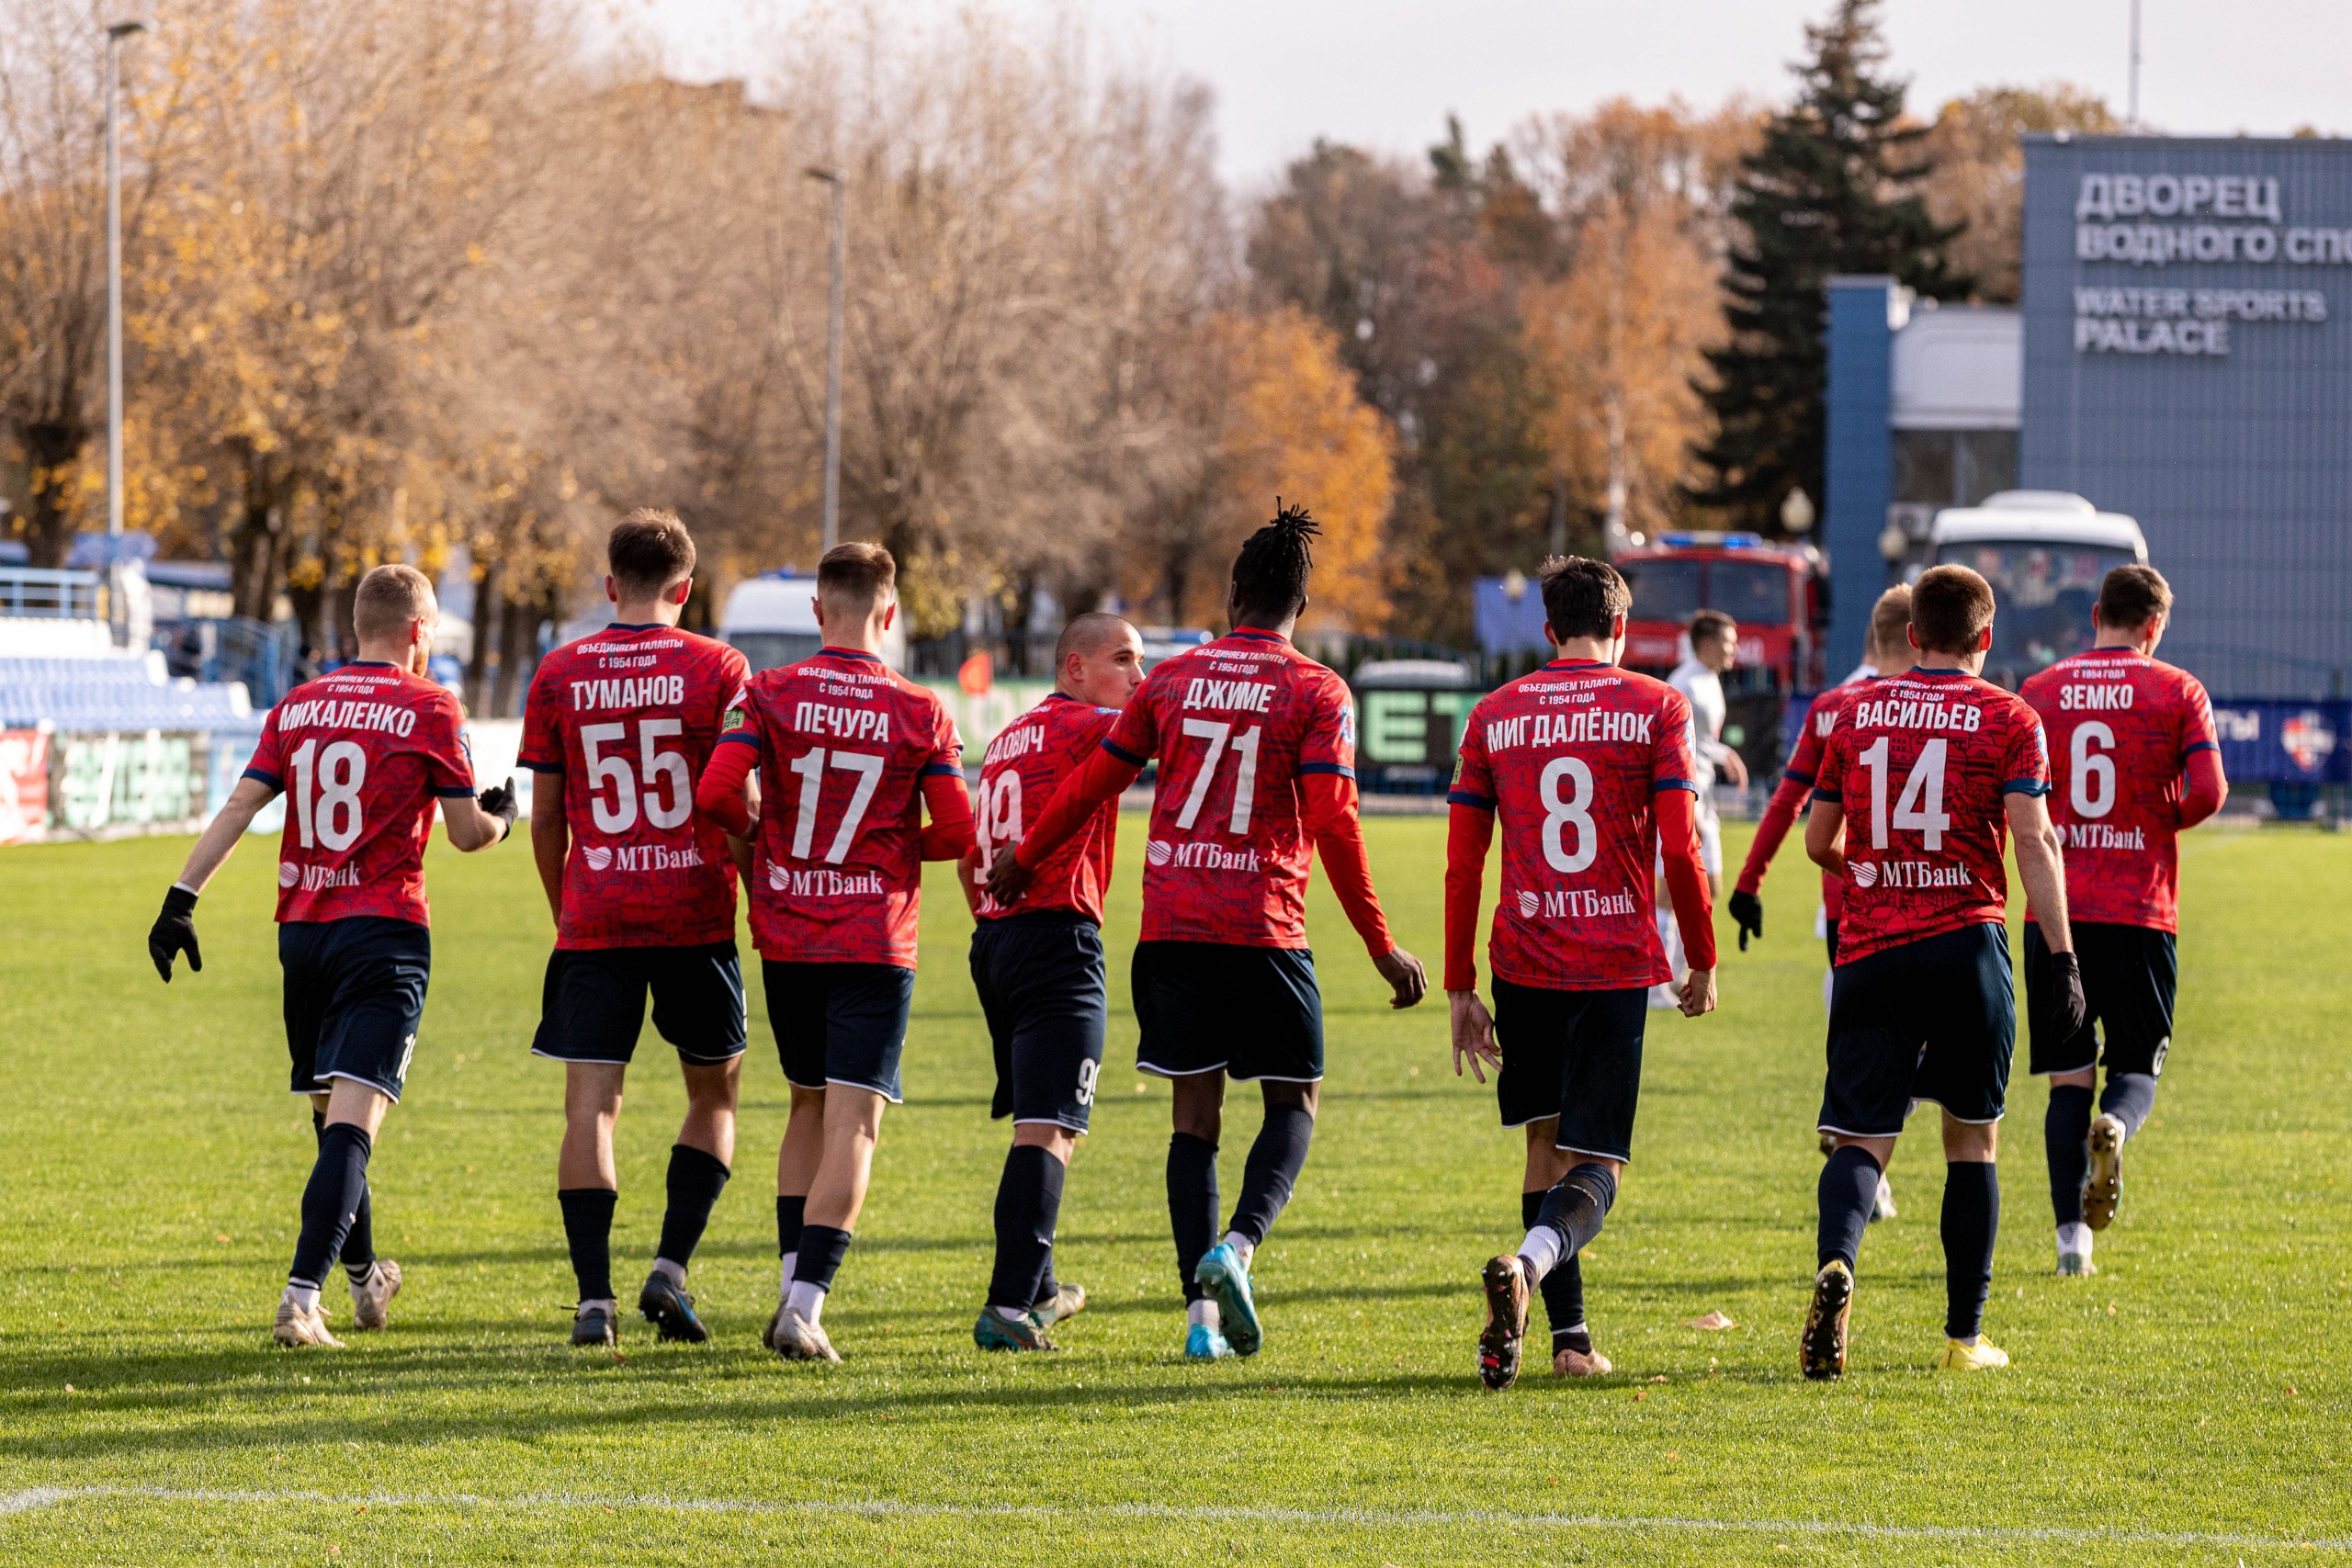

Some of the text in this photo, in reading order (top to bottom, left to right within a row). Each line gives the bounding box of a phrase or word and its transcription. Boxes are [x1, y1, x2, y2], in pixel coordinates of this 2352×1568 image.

[2075, 174, 2281, 224] ДВОРЕЦ
[2075, 224, 2352, 268] ВОДНОГО СП
[2074, 286, 2327, 321] WATER SPORTS
[2074, 318, 2231, 355] PALACE
[608, 656, 631, 669] 1954
[632, 654, 657, 668] ГОДА
[639, 638, 684, 651] ТАЛАНТЫ
[1248, 651, 1288, 666] ТАЛАНТЫ
[857, 673, 898, 688] ТАЛАНТЫ
[1217, 661, 1238, 672] 1954
[1238, 663, 1259, 675] ГОДА
[1518, 677, 1622, 694] ОБЪЕДИНЯЕМ ТАЛАНТЫ
[570, 675, 684, 712] ТУМАНОВ
[828, 683, 849, 696] 1954
[851, 685, 873, 700] ГОДА
[1182, 678, 1276, 714] ДЖИМЕ
[1540, 693, 1596, 705] С 1954 ГОДА
[1899, 690, 1920, 700] 1954
[1921, 692, 1945, 702] ГОДА
[2059, 684, 2133, 711] ЗЕМКО
[278, 699, 416, 739] МИХАЛЕНКО
[794, 702, 889, 743] ПЕЧУРА
[1487, 706, 1655, 754] МИГДАЛЁНОК
[1855, 699, 1982, 732] ВАСИЛЬЕВ
[580, 718, 693, 834] 55
[1175, 717, 1261, 835] 71
[2070, 720, 2116, 818] 6
[290, 739, 367, 852] 18
[790, 746, 885, 864] 17
[1860, 736, 1950, 851] 14
[1540, 756, 1597, 874] 8
[300, 861, 360, 892] МТанк
[396, 1032, 416, 1084] 1
